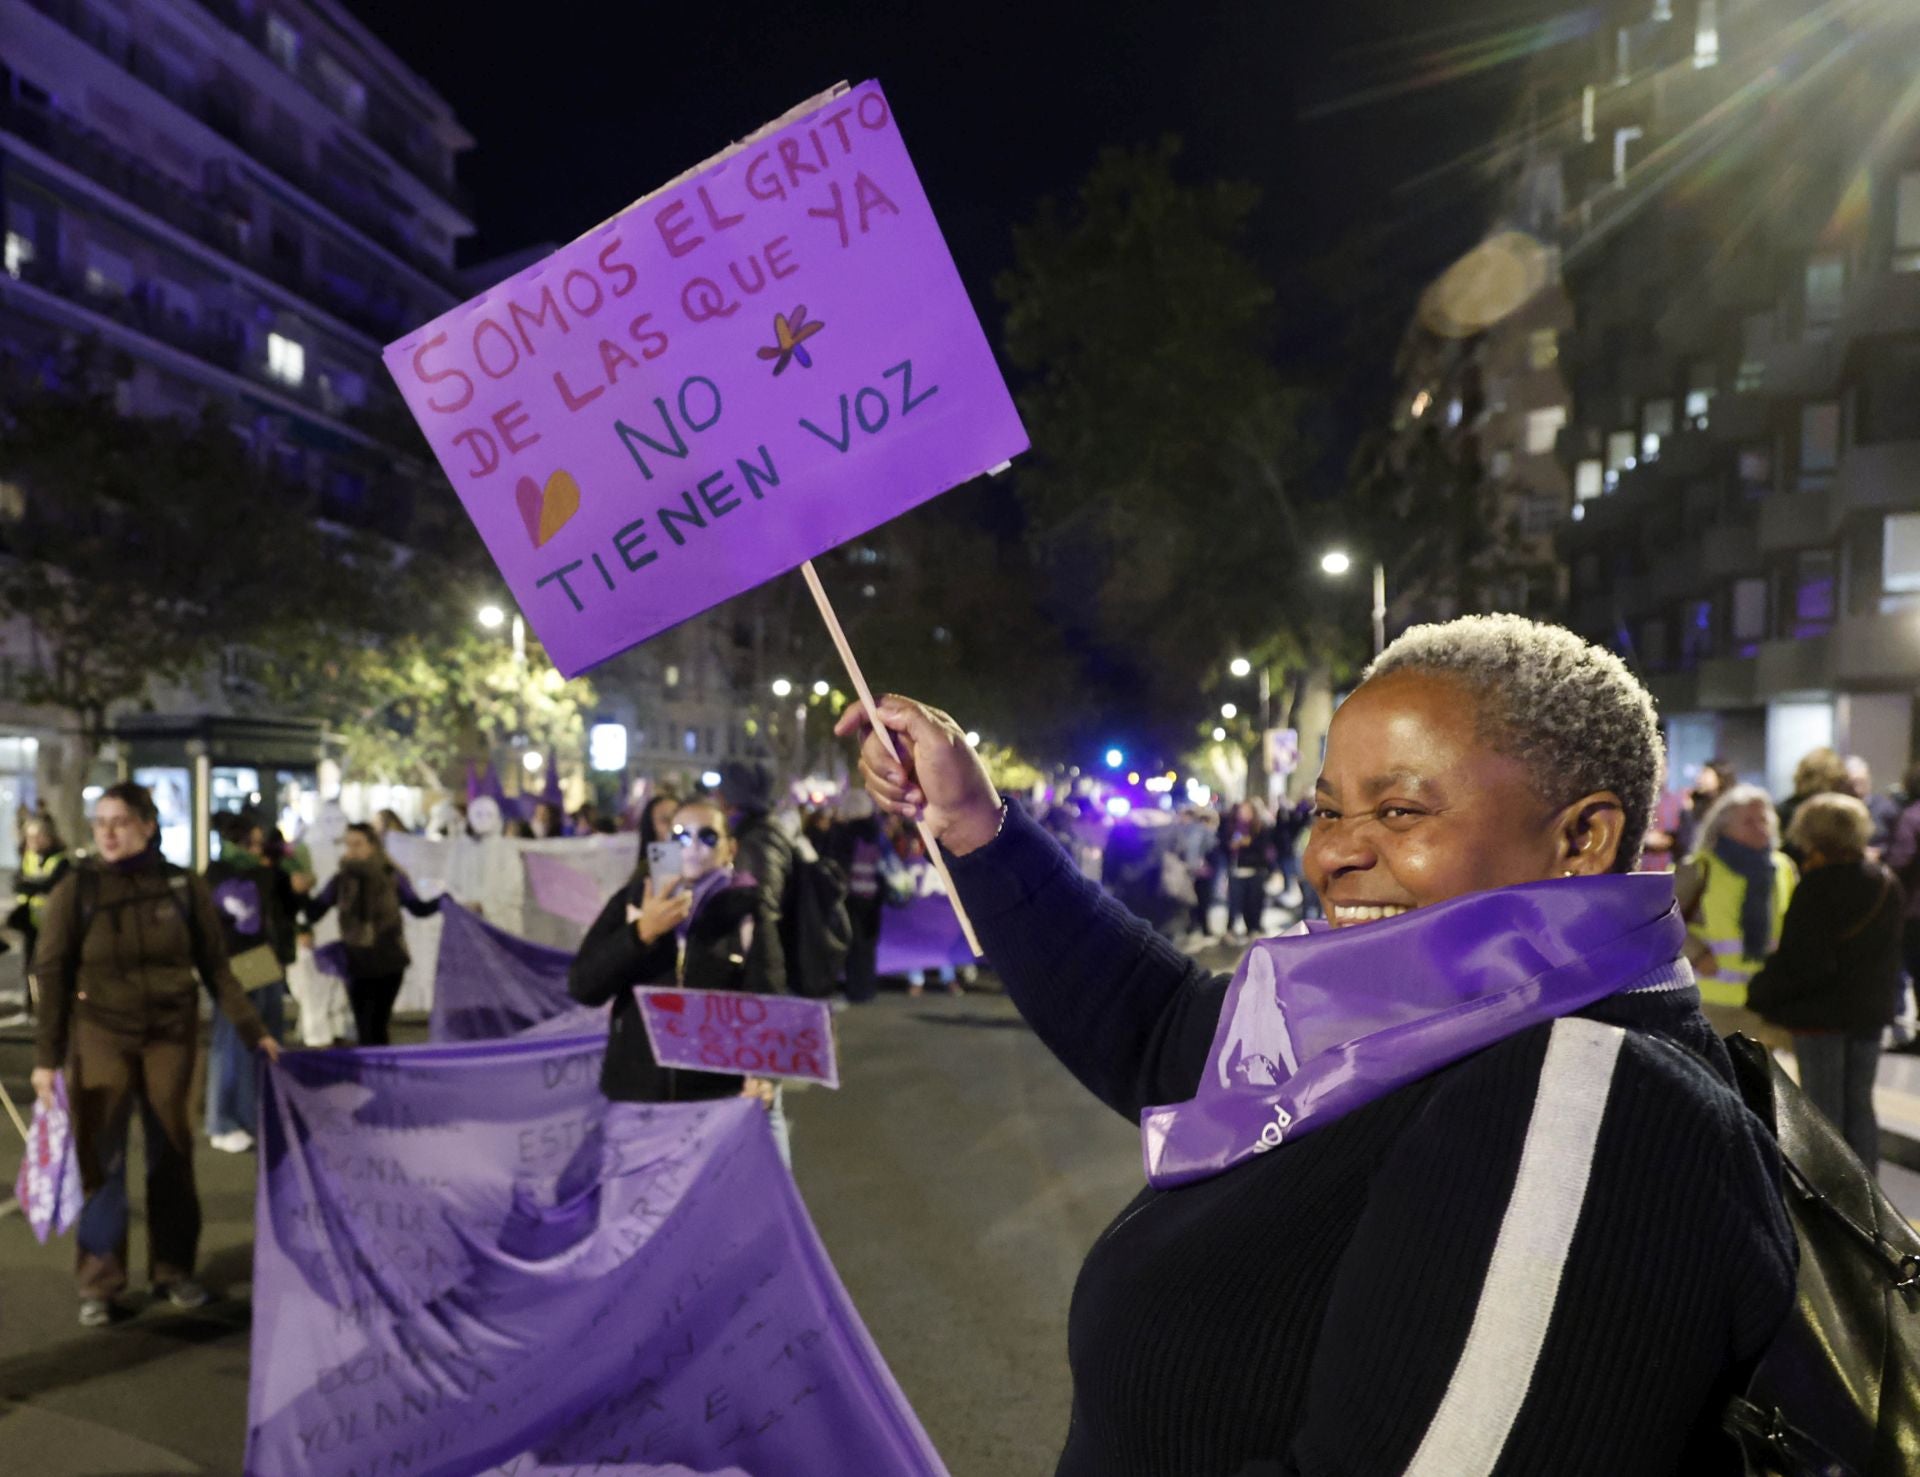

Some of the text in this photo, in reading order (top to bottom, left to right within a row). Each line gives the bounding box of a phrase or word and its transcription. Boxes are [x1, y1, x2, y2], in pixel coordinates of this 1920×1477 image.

[412, 92, 889, 414] SOMOS EL GRITO
[453, 171, 901, 479] DE LAS QUE YA
[536, 359, 939, 612] TIENEN VOZ
[614, 376, 722, 480] NO
[699, 1044, 824, 1077] SOLA
[703, 994, 768, 1027] NO
